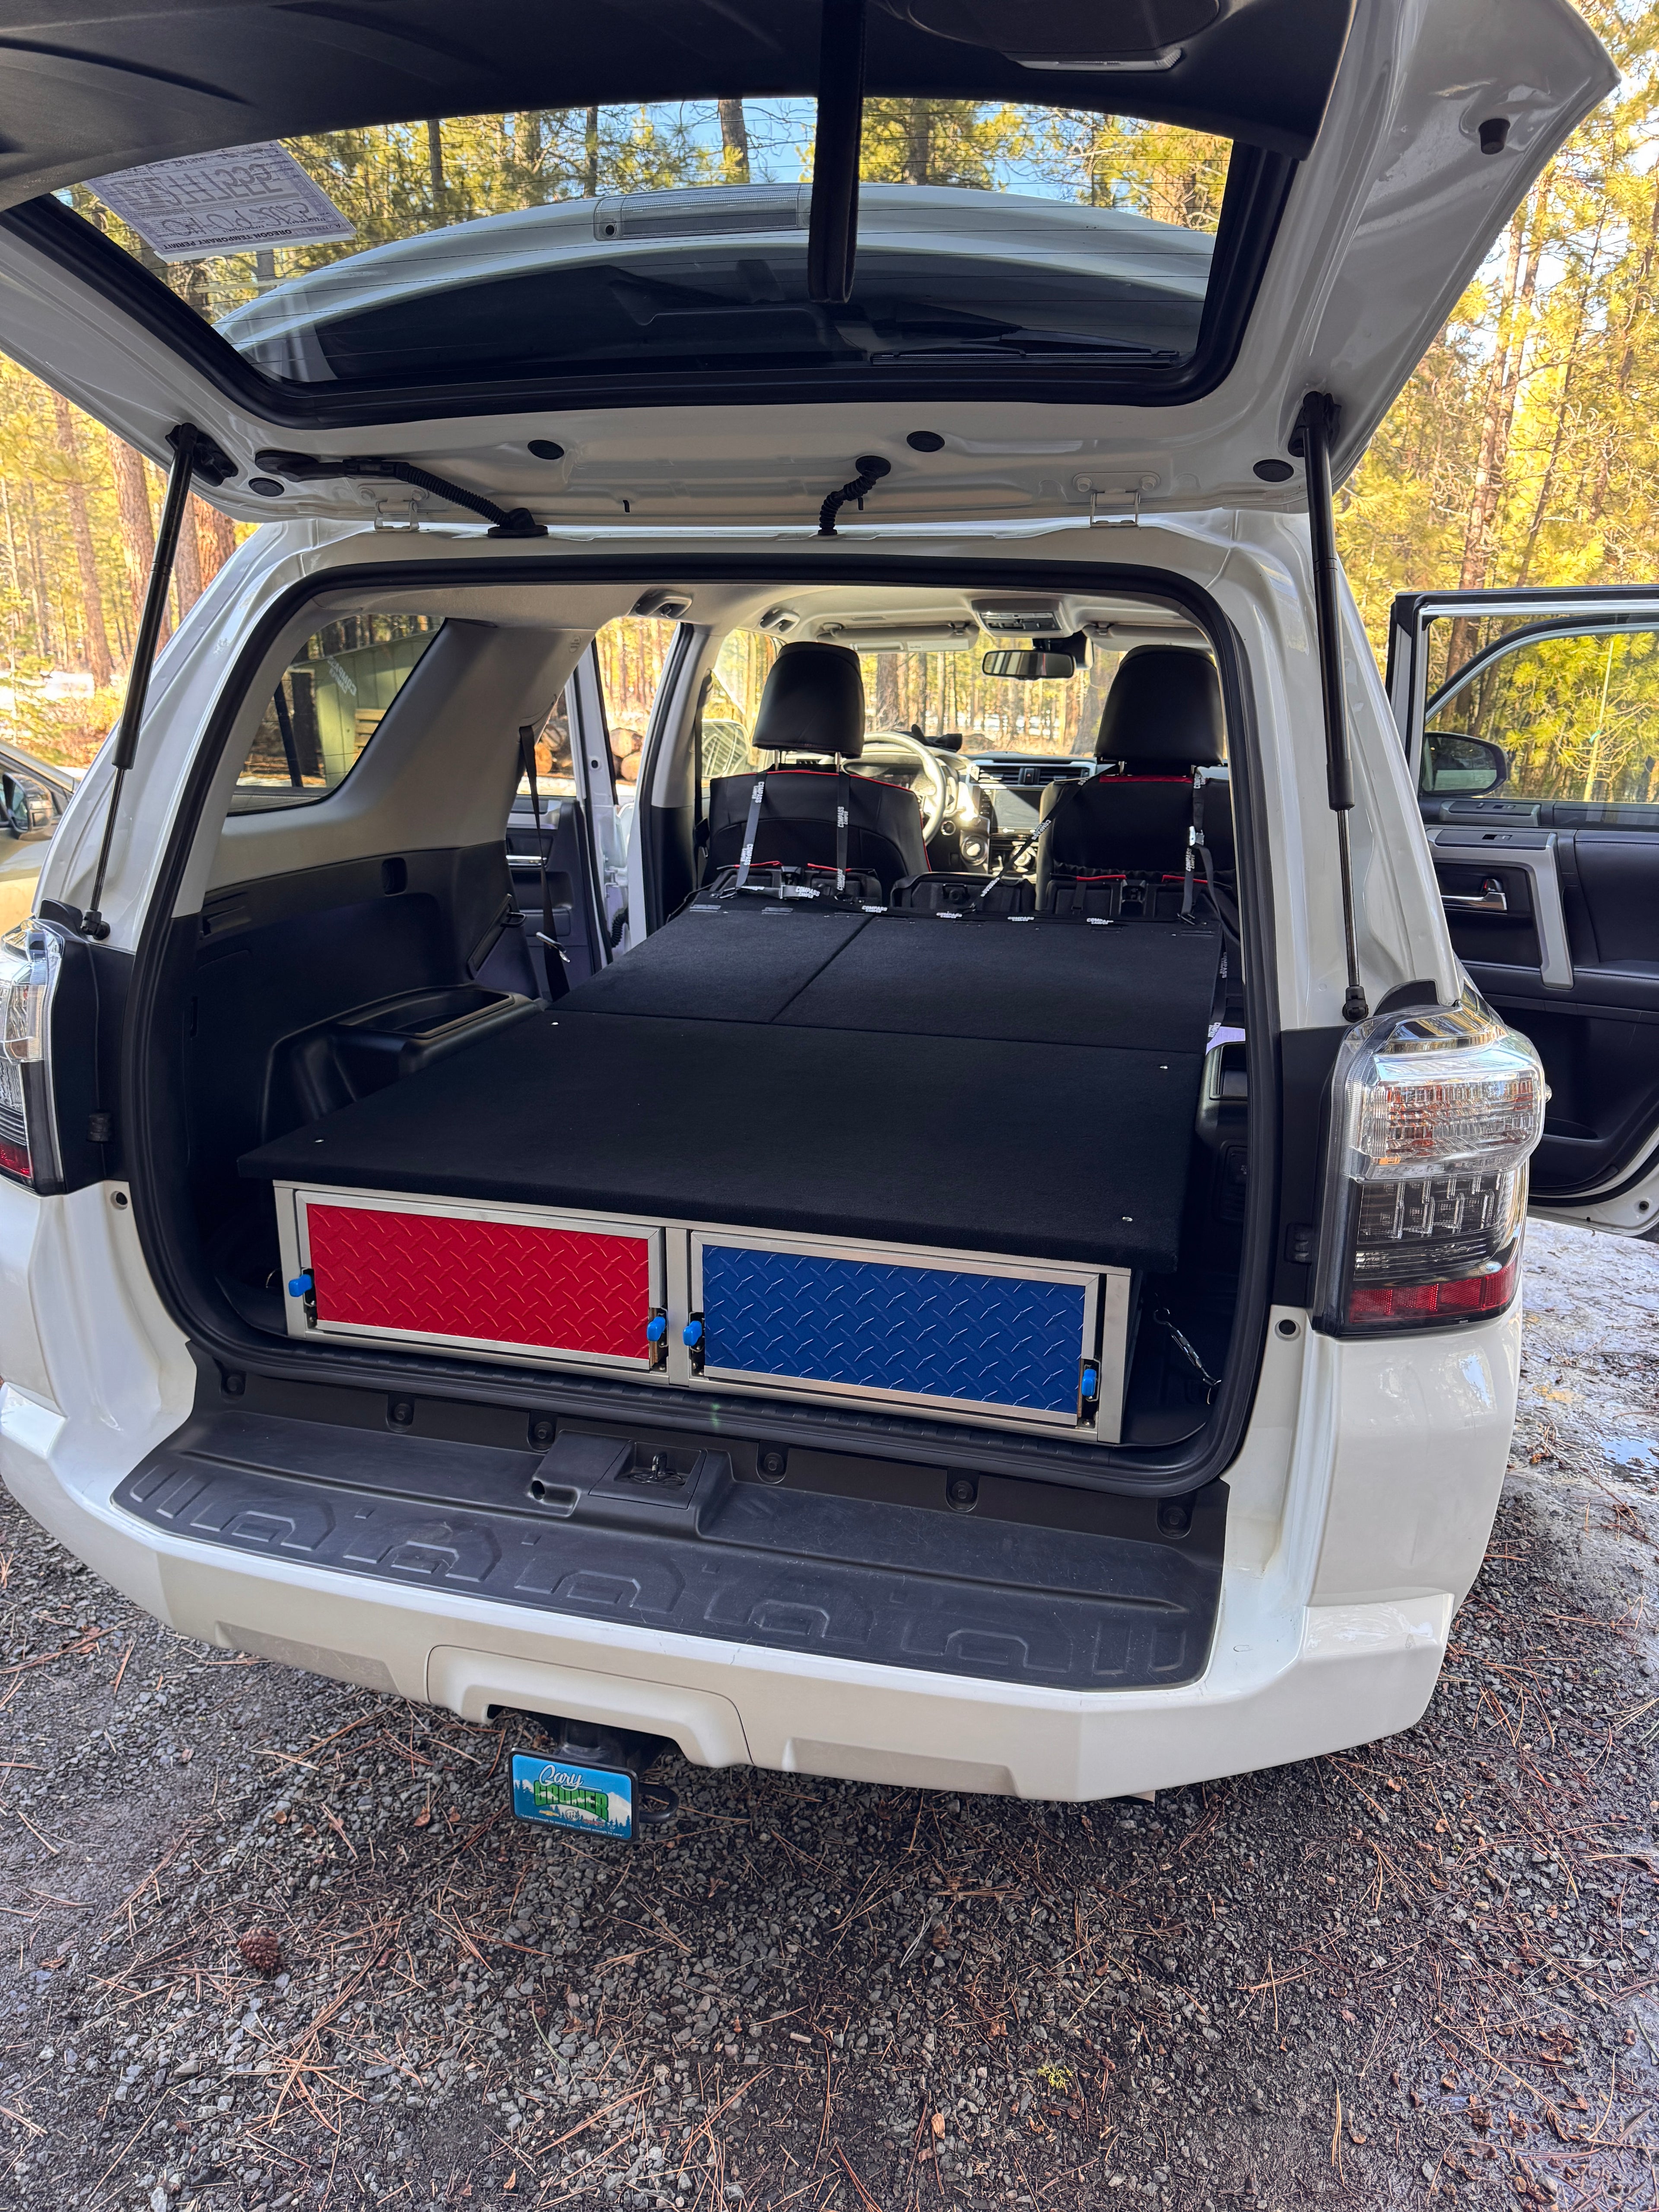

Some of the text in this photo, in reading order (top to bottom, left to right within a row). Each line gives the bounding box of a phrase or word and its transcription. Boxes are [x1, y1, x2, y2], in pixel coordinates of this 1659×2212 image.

[160, 229, 294, 249] OREGON TEMPORARY PERMIT
[755, 781, 765, 803] COMPASS
[1031, 819, 1051, 840] COMPASS
[744, 844, 753, 865] COMPASS
[795, 886, 820, 897] COMPASS
[539, 1764, 602, 1791] Gary
[534, 1780, 609, 1821] GRUNER
